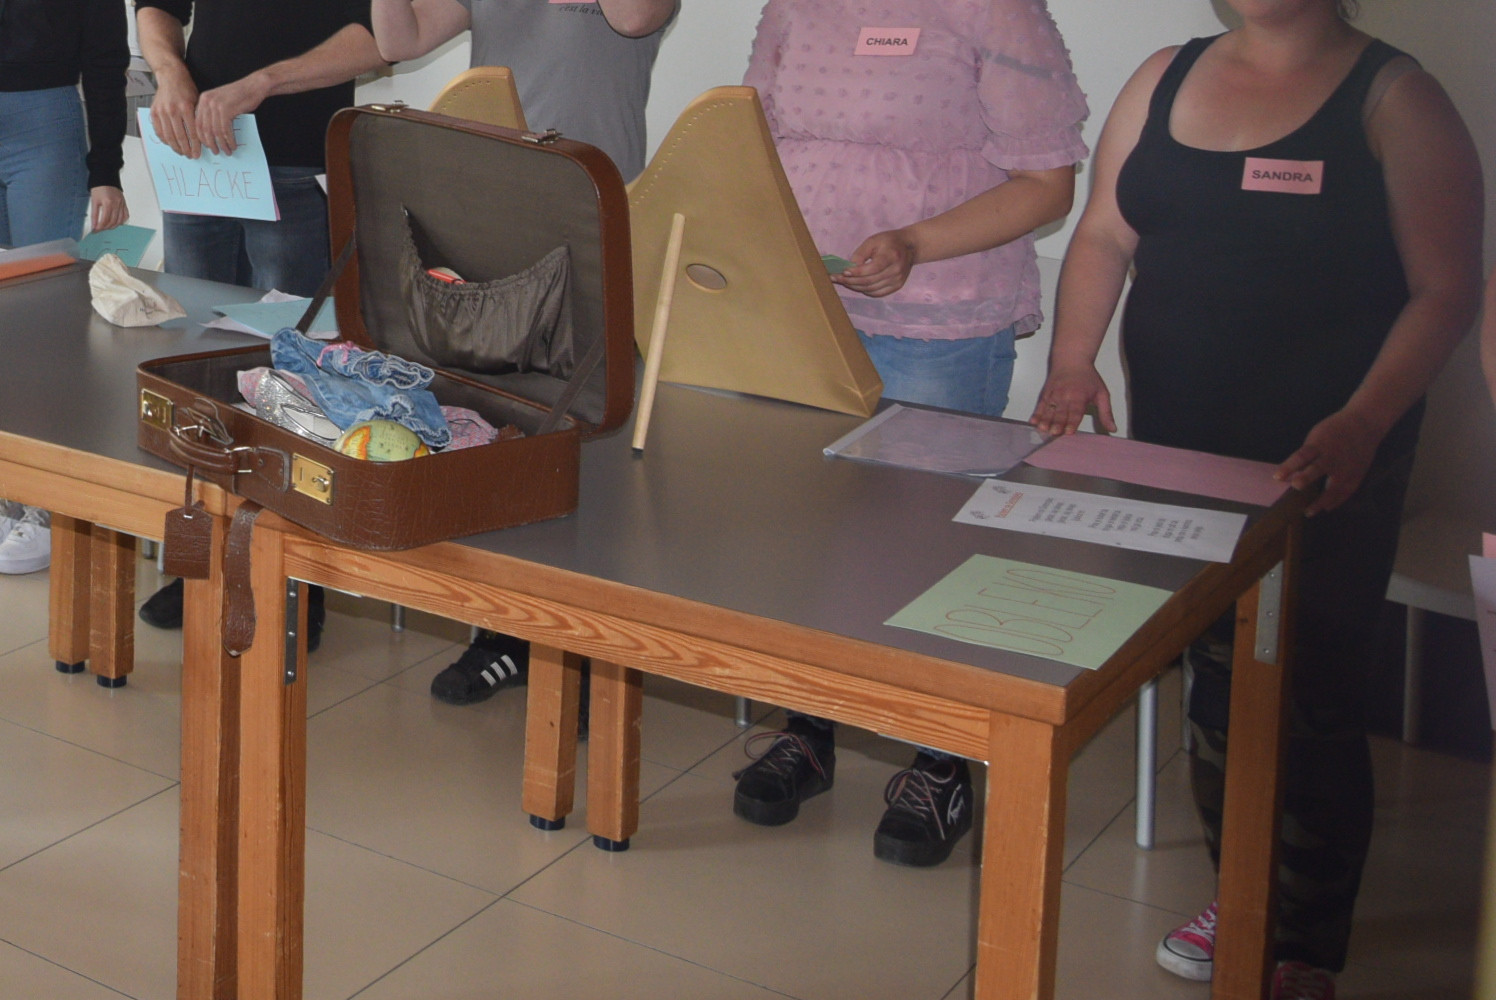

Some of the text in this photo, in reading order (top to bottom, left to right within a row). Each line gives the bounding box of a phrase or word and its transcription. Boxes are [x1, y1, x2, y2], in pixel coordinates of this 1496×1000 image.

[866, 36, 909, 47] CHIARA
[1251, 169, 1313, 183] SANDRA
[933, 567, 1117, 657] OBLEKO
